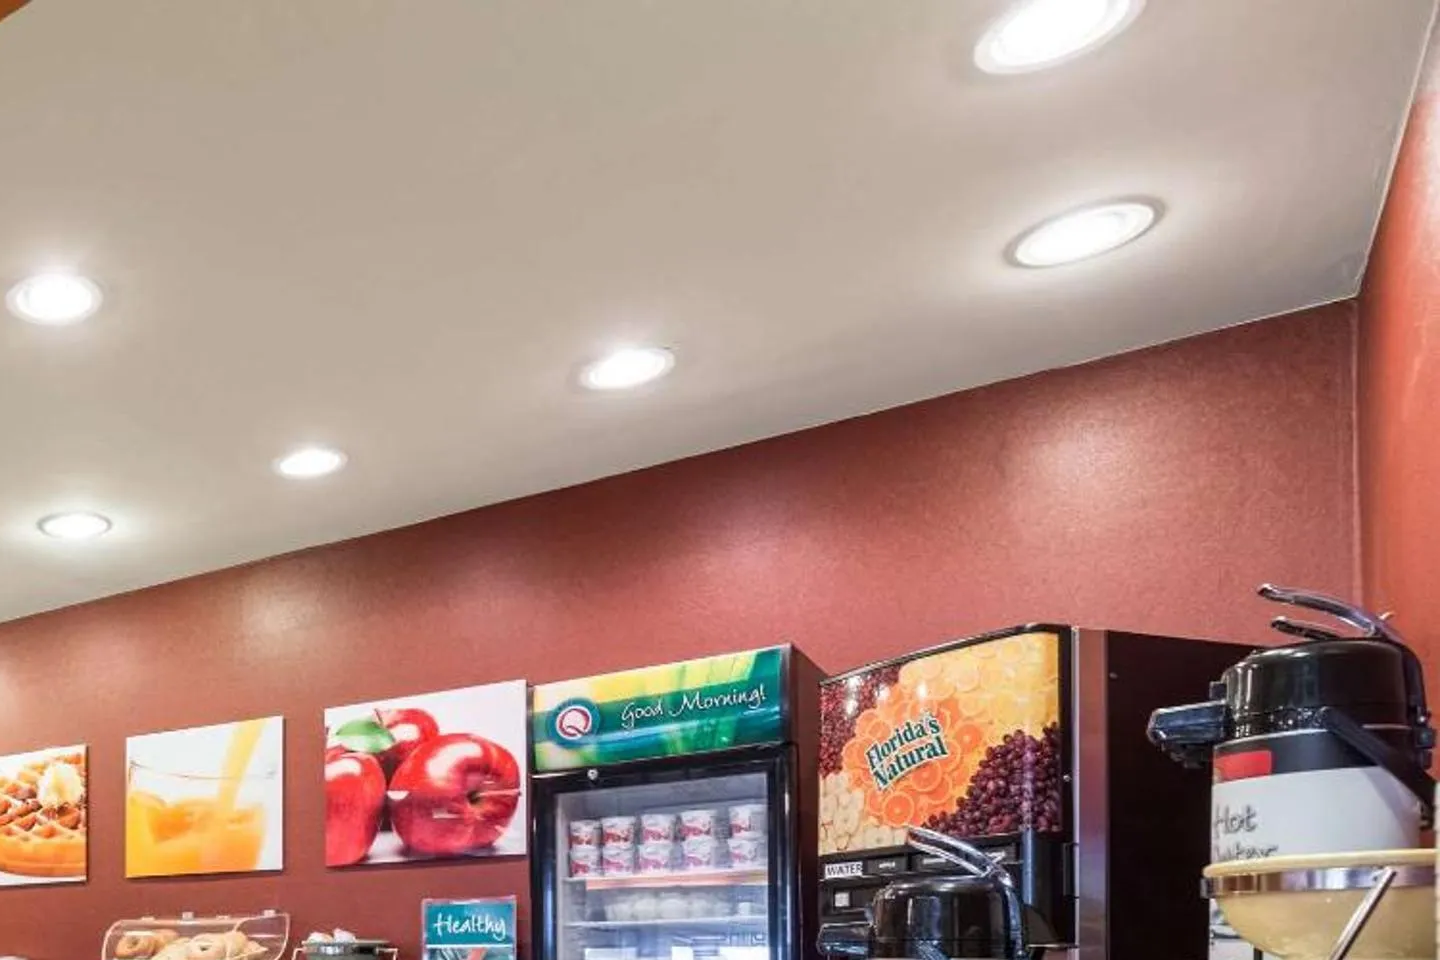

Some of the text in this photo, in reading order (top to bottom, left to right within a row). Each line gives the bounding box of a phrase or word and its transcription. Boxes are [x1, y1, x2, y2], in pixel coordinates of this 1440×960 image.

[621, 684, 766, 728] Good Morning!
[866, 717, 940, 770] Florida's
[874, 736, 948, 785] Natural
[827, 863, 863, 877] WATER
[433, 912, 507, 940] Healthy
